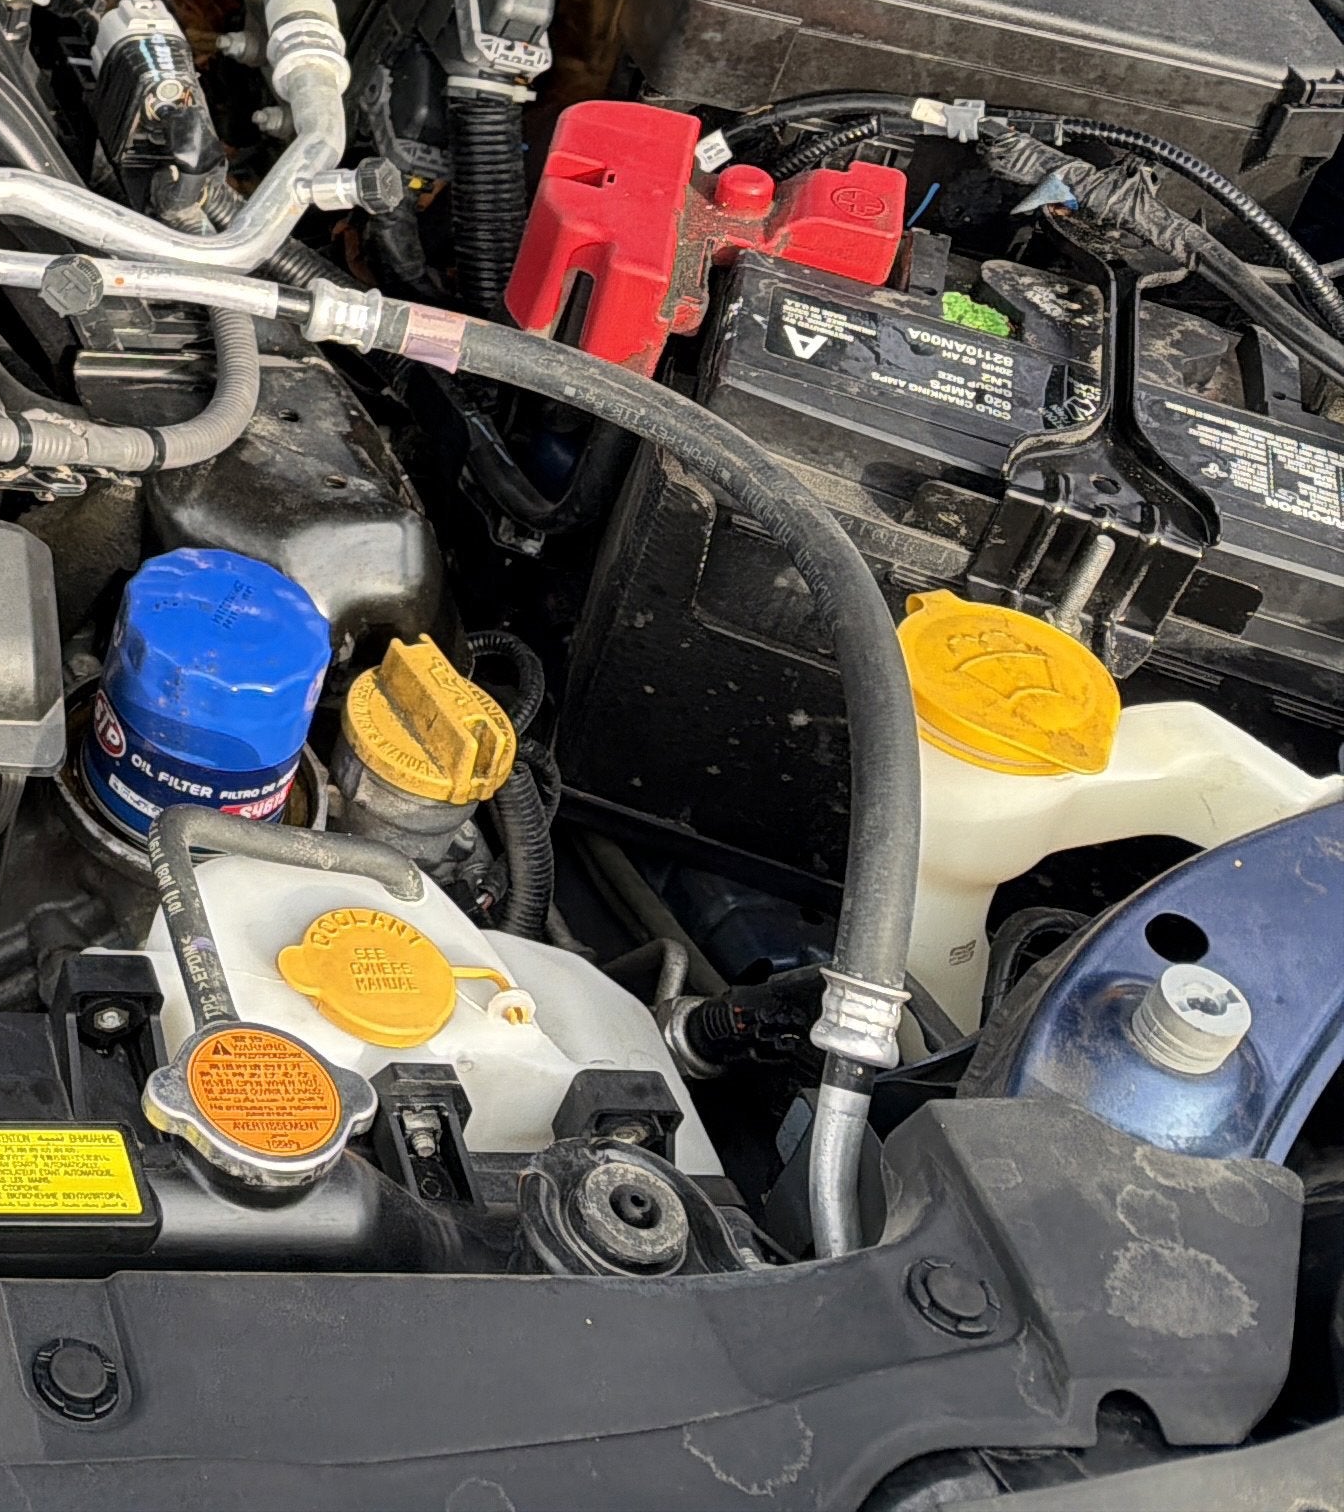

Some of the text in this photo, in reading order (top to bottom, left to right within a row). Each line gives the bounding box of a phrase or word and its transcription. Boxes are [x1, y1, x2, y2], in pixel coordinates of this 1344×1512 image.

[907, 327, 1014, 368] 82110AN00A
[871, 371, 1012, 420] COLD CRANKING AMPS
[929, 379, 1012, 411] 620 AMPS
[131, 753, 154, 778] OIL
[157, 771, 213, 799] FILTER
[219, 789, 261, 800] FILTRO
[310, 910, 422, 947] COOLANT
[353, 947, 387, 961] SEE
[355, 976, 419, 992] MANUAL
